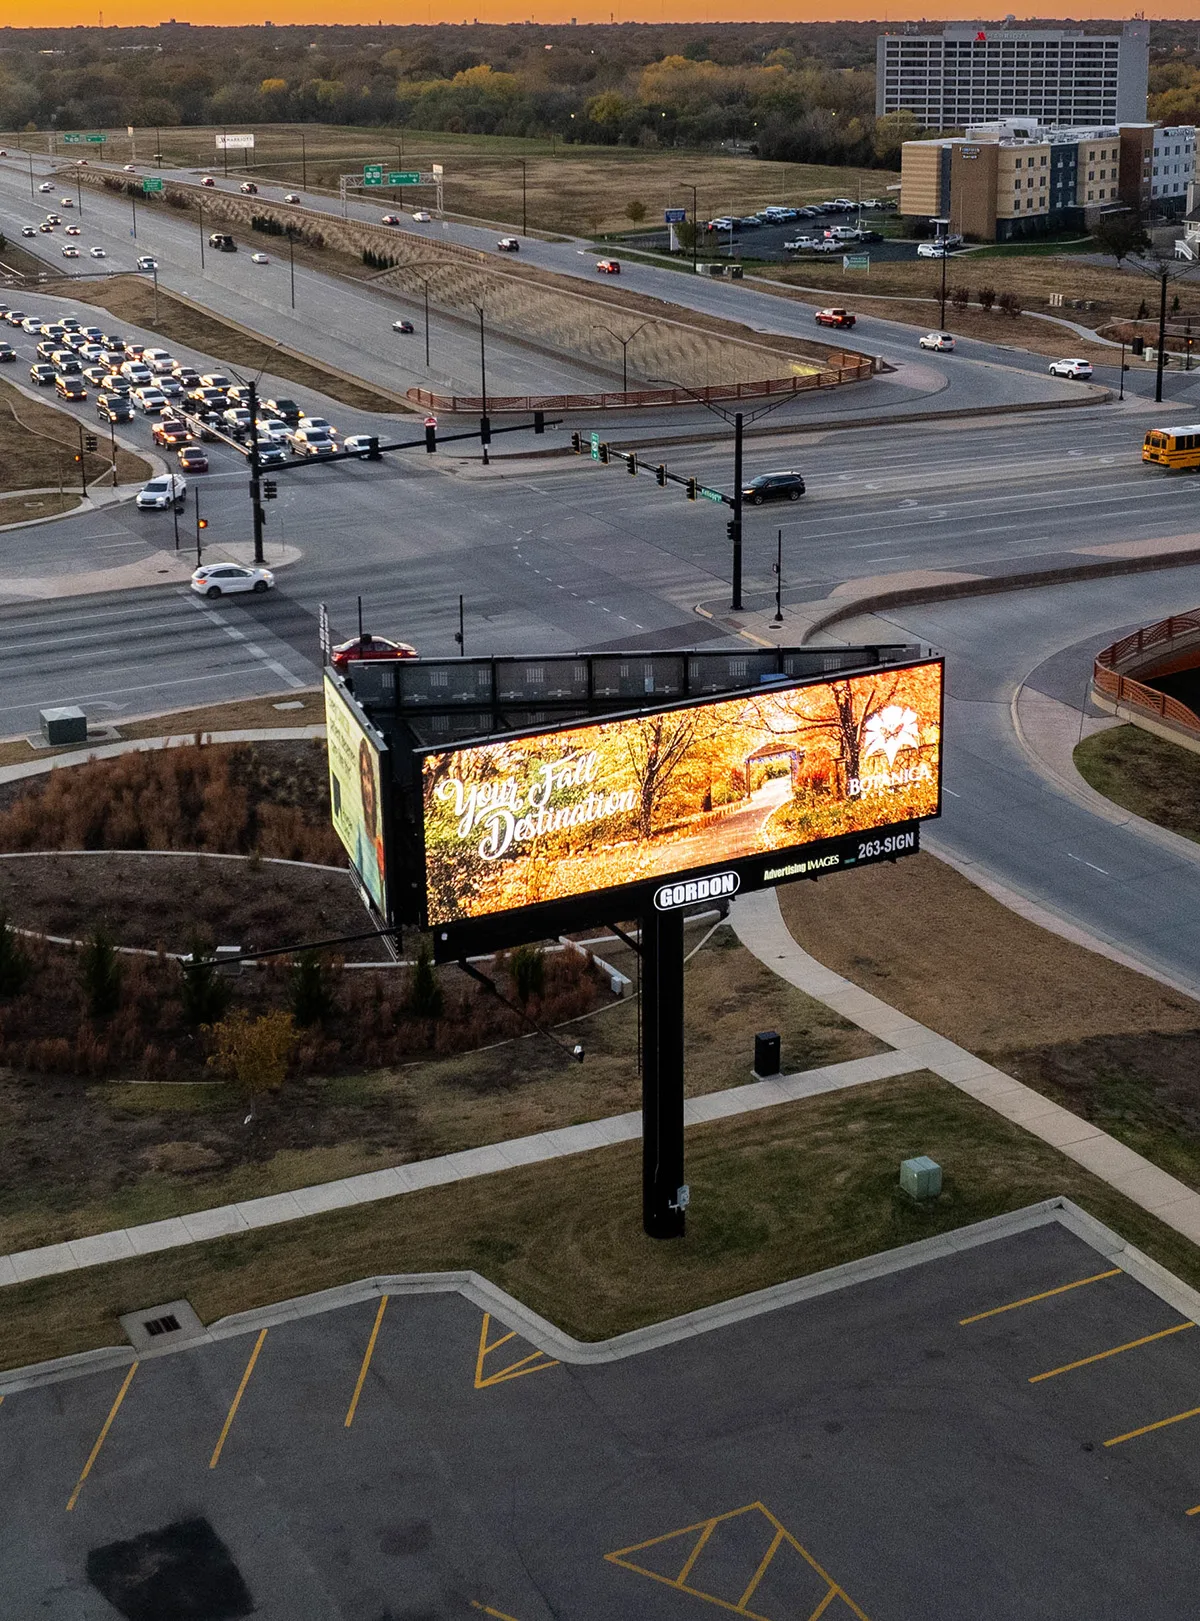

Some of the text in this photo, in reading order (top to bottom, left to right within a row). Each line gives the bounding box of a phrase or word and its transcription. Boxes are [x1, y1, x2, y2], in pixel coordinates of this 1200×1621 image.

[434, 751, 598, 838] Your Fall
[849, 764, 933, 796] BOTANICA
[478, 789, 639, 860] Destination
[763, 832, 914, 880] Advertising IMAGES 263-SIGN
[660, 874, 734, 907] GORDON
